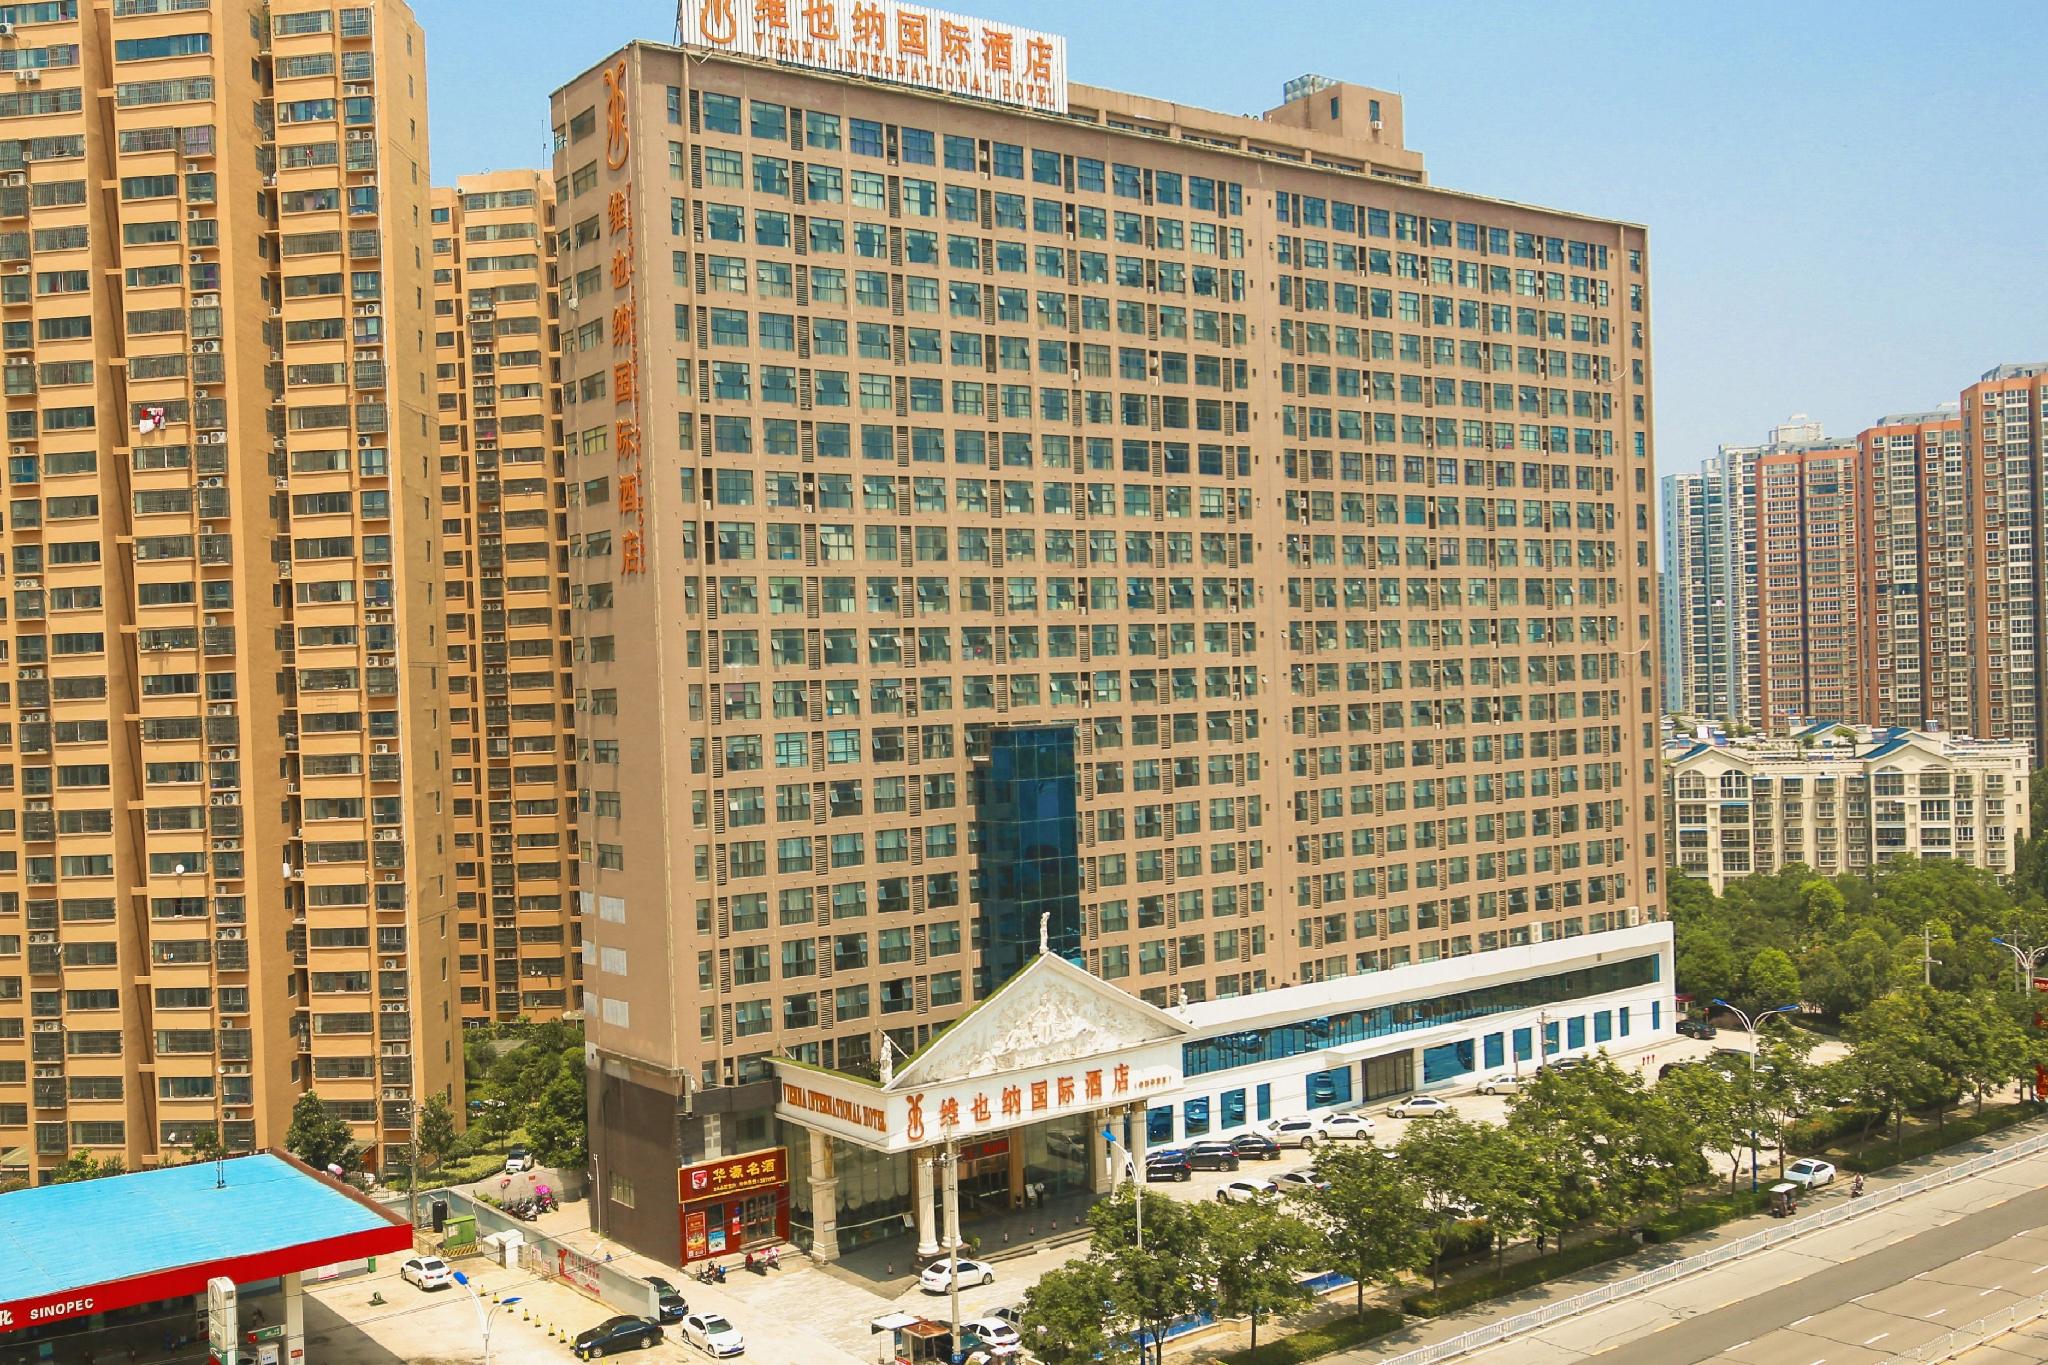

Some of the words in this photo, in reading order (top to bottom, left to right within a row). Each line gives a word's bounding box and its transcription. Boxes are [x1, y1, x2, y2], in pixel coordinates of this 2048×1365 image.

[753, 32, 827, 63] VIENNA
[838, 48, 993, 94] INTERNATIONAL
[1002, 78, 1056, 106] HOTEL
[754, 0, 1054, 82] 维也纳国际酒店
[608, 188, 640, 577] 维也纳国际酒店
[783, 1083, 807, 1109] VIENNA
[808, 1089, 862, 1125] INTERNATIONAL
[863, 1105, 887, 1132] HOTEL
[939, 1063, 1130, 1128] 维也纳国际酒店
[712, 1158, 776, 1184] 华源名酒
[30, 1298, 94, 1320] SINOPEC
